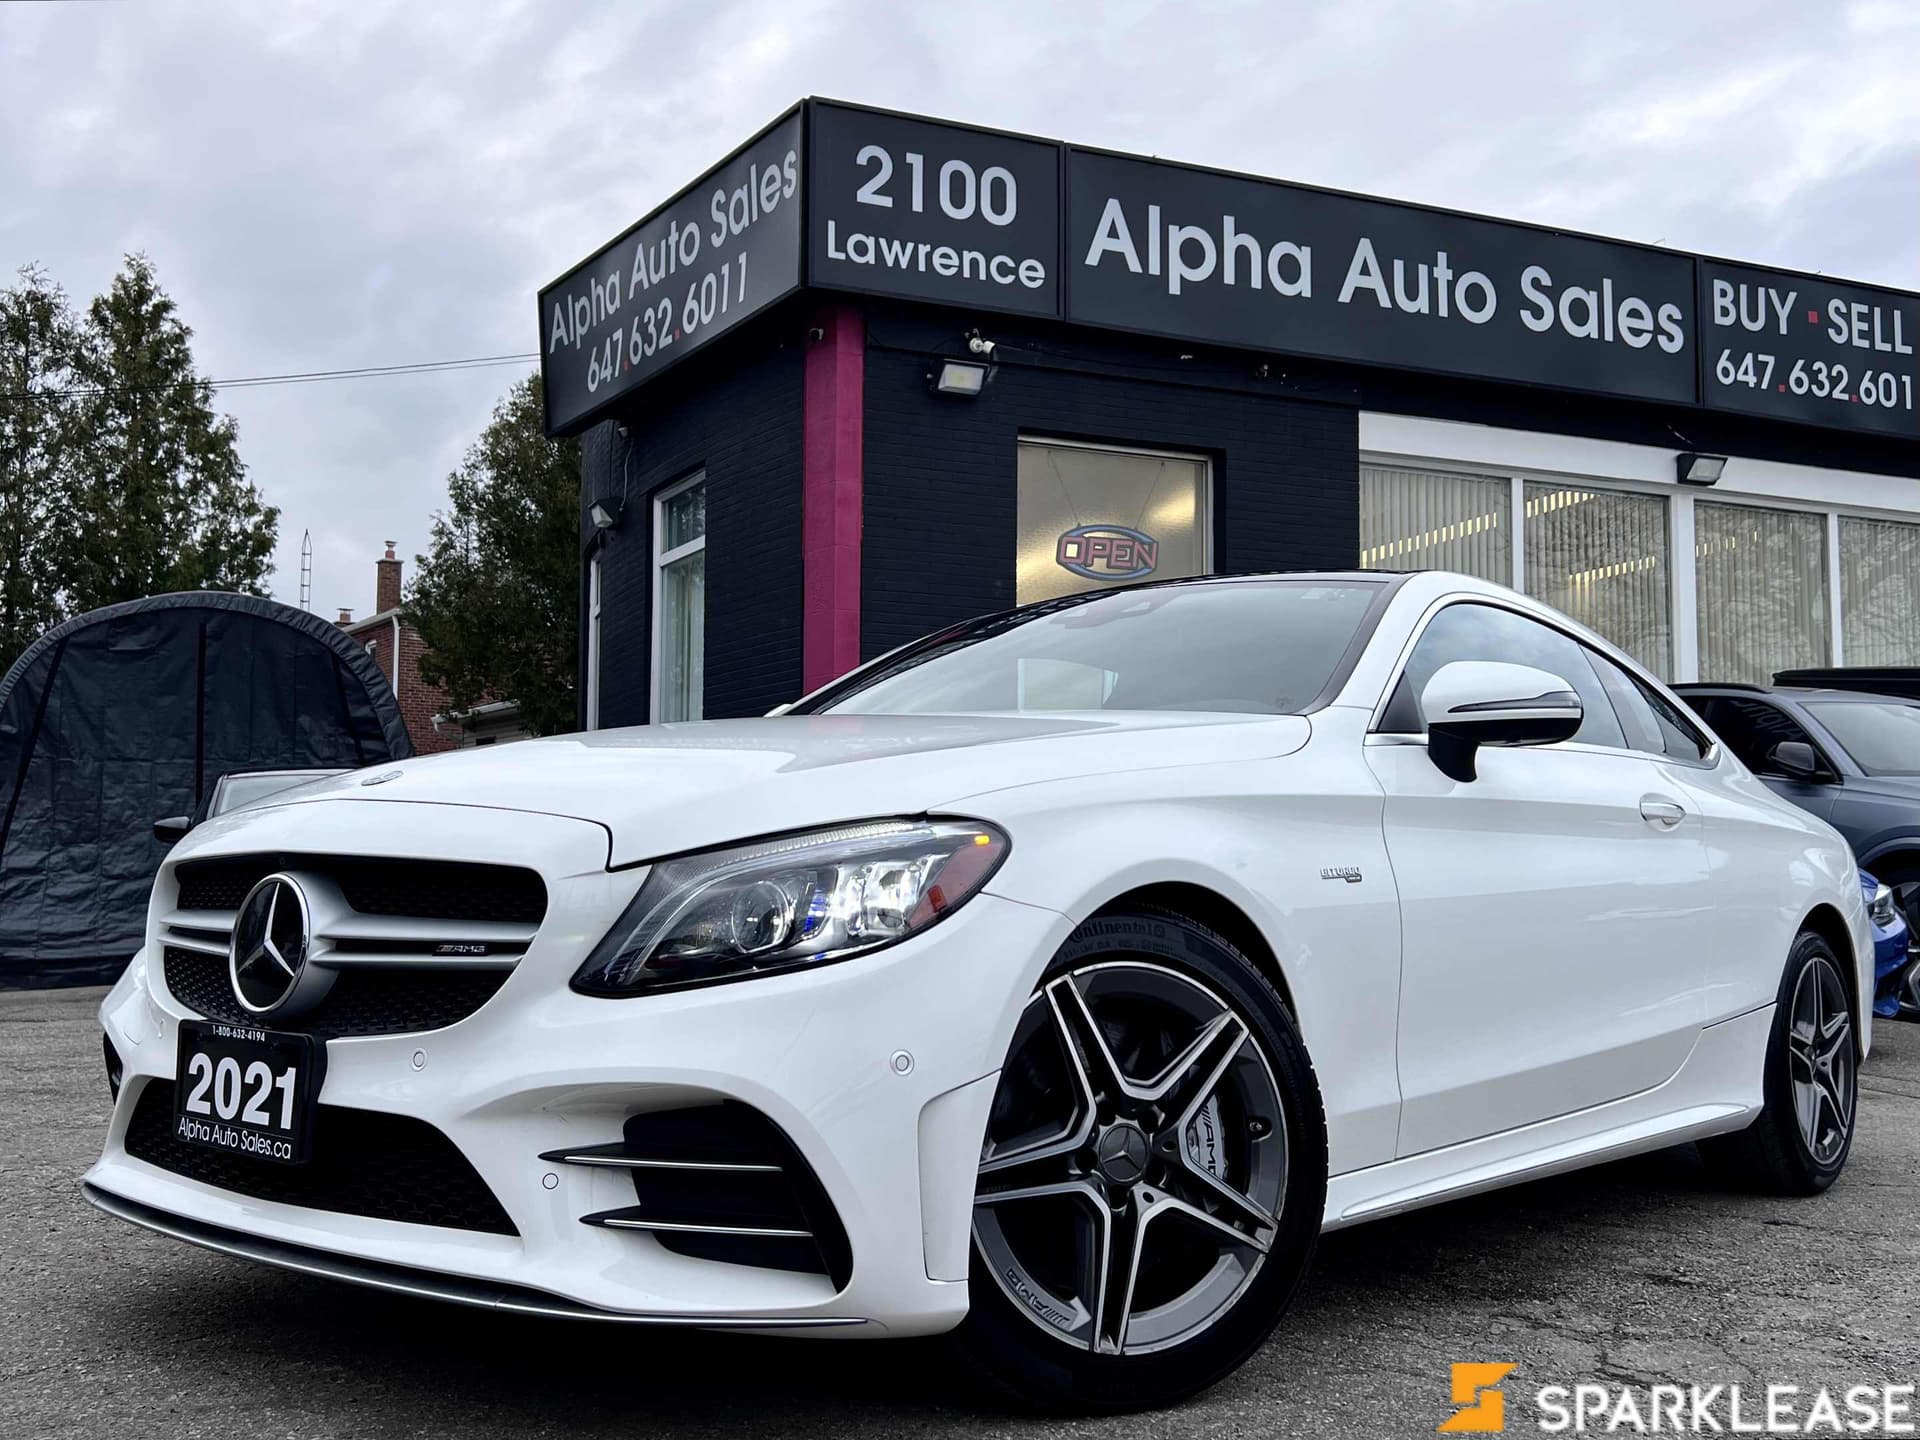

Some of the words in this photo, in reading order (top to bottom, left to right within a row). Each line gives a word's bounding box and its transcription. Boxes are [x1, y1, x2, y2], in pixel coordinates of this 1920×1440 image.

[856, 145, 1017, 226] 2100
[550, 270, 621, 354] Alpha
[629, 220, 700, 300] Auto
[710, 150, 797, 248] Sales
[827, 219, 1046, 288] Lawrence
[1084, 198, 1312, 295] Alpha
[1337, 237, 1498, 324] Auto
[1519, 265, 1685, 354] Sales
[587, 251, 747, 393] 647.632.6011
[1713, 279, 1798, 335] BUY
[1827, 298, 1913, 354] SELL
[1060, 536, 1158, 570] OPEN
[212, 1025, 265, 1042] 1-800-632-4194
[186, 1053, 297, 1130] 2021
[177, 1117, 210, 1141] Alpha
[211, 1124, 239, 1148] Auto
[240, 1130, 292, 1160] Sales.ca
